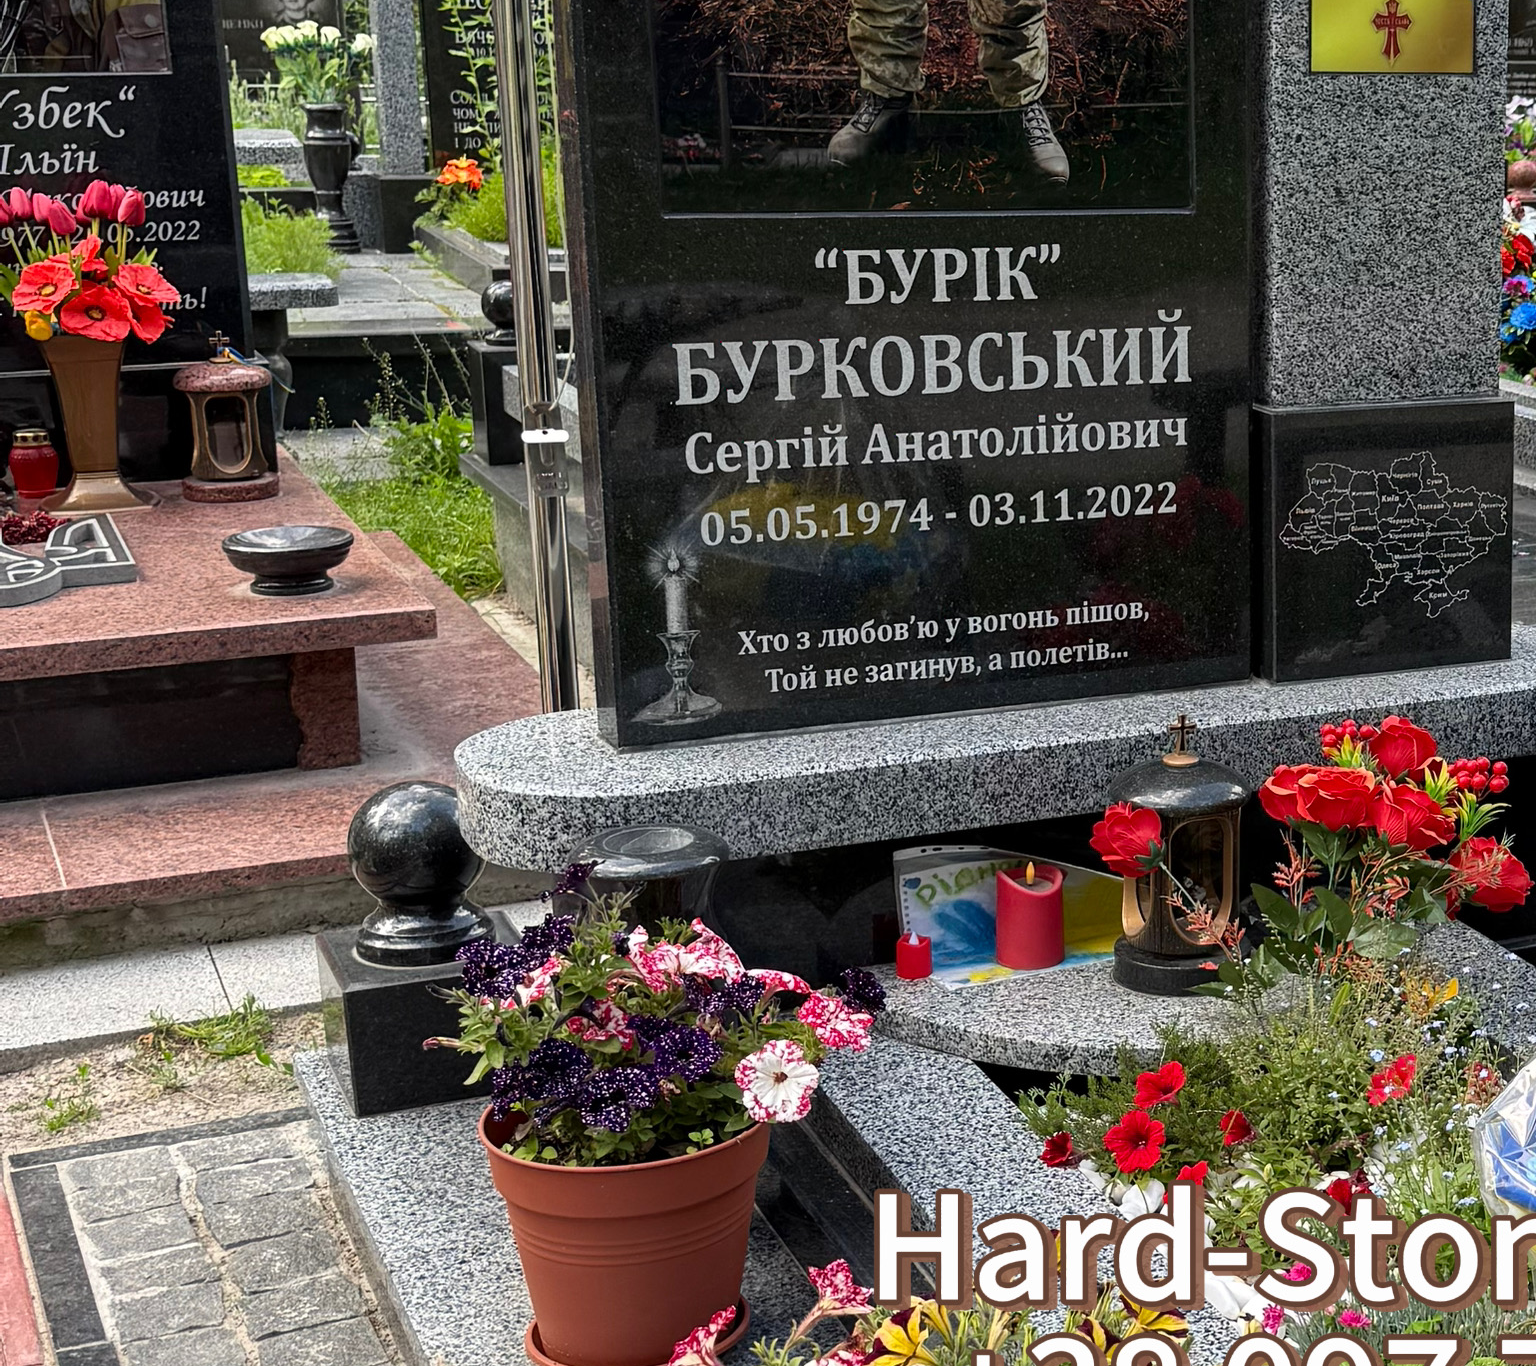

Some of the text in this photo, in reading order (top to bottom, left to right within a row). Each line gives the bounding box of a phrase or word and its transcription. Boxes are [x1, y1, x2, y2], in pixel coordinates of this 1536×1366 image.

[814, 244, 1062, 305] “БУРІК”
[672, 308, 1192, 406] БУРКОВСЬКИЙ
[685, 412, 1188, 483] Сергій Анатолійович
[700, 497, 933, 546] 05.05.1974
[969, 481, 1177, 526] 03.11.2022
[737, 601, 1150, 655] Хто з любов’ю у вогонь пішов,
[765, 640, 1129, 693] Той не загинув, а полетів...
